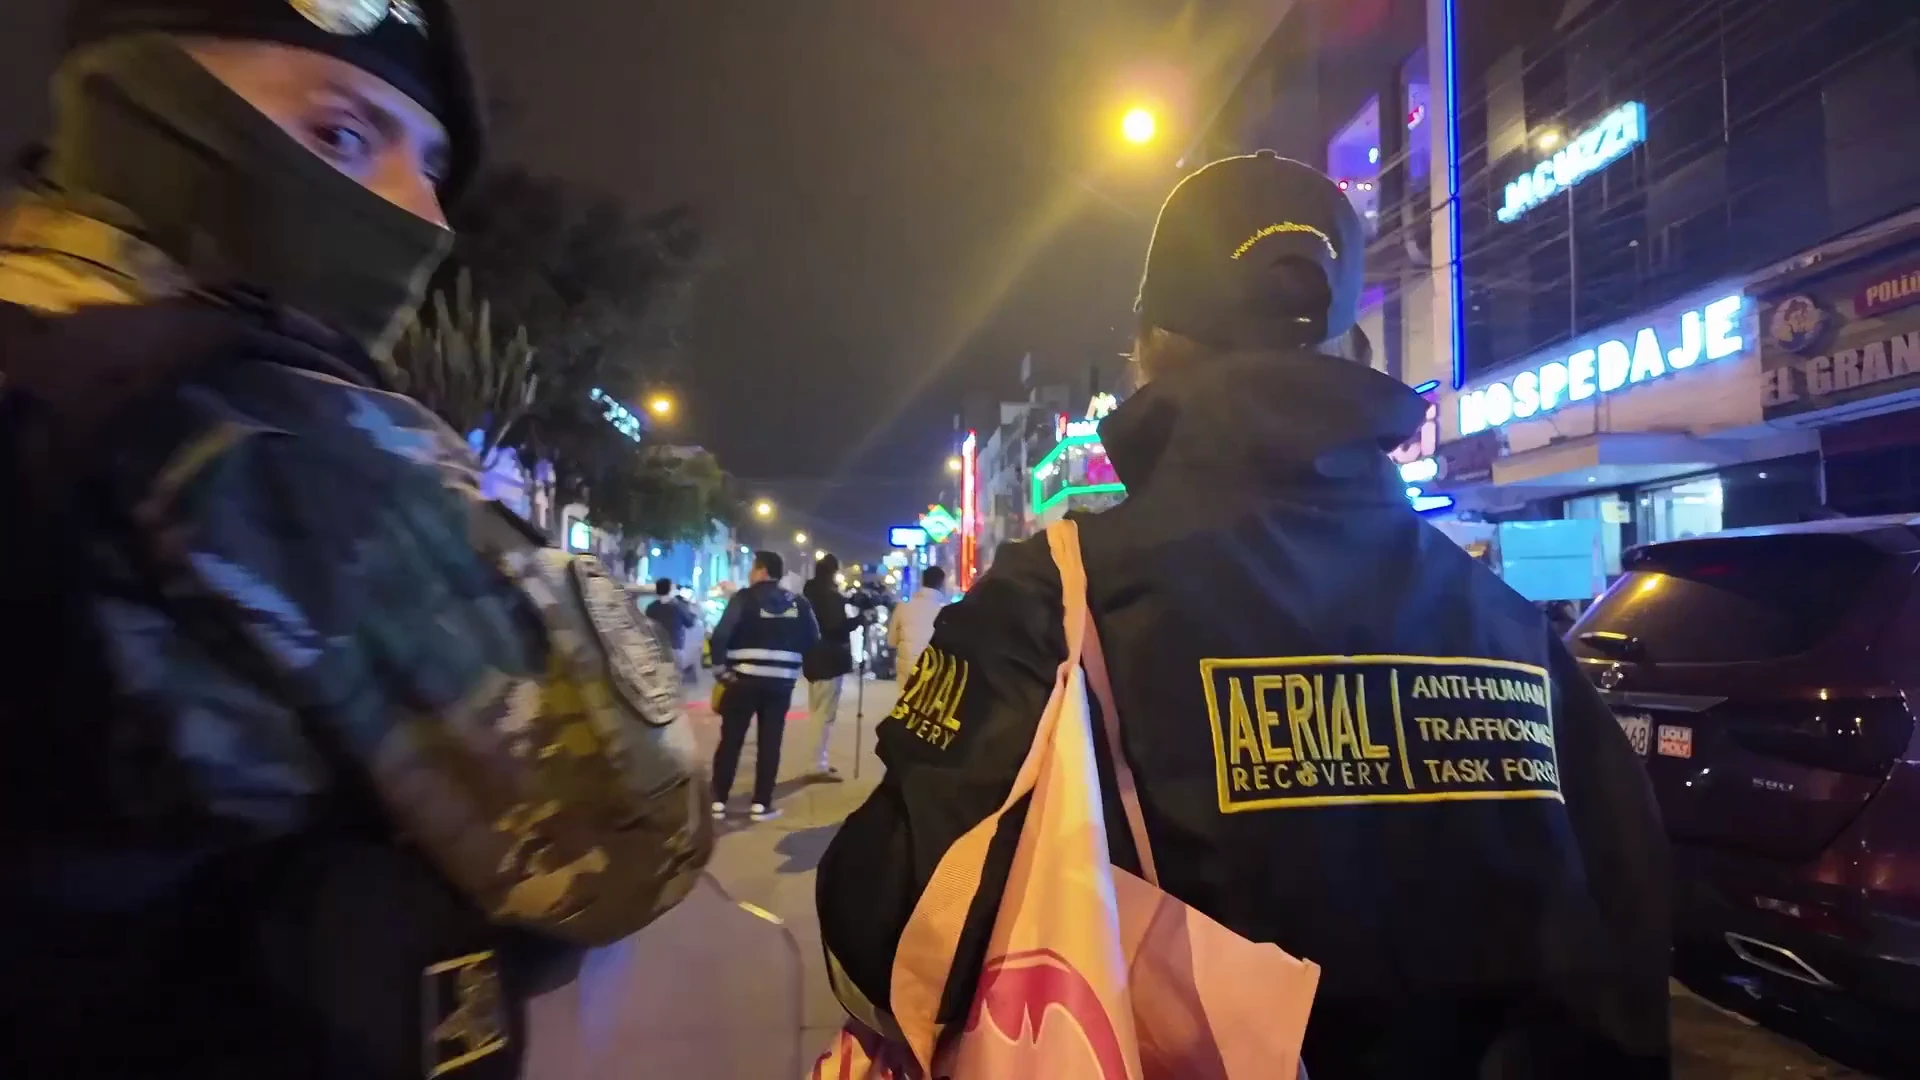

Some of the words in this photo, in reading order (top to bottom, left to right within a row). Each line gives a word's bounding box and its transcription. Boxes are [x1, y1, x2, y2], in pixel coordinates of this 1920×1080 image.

[1459, 294, 1744, 437] HOSPEDAJE
[1761, 366, 1800, 408] EL
[1806, 331, 1920, 396] GRAN
[903, 644, 968, 732] RIAL
[1411, 675, 1546, 708] ANTI-HUMAN
[1229, 672, 1390, 765] AERIAL
[1623, 723, 1647, 753] 68
[1230, 761, 1391, 792] RECOVERY
[1423, 757, 1495, 784] TASK
[1501, 757, 1559, 786] FORC
